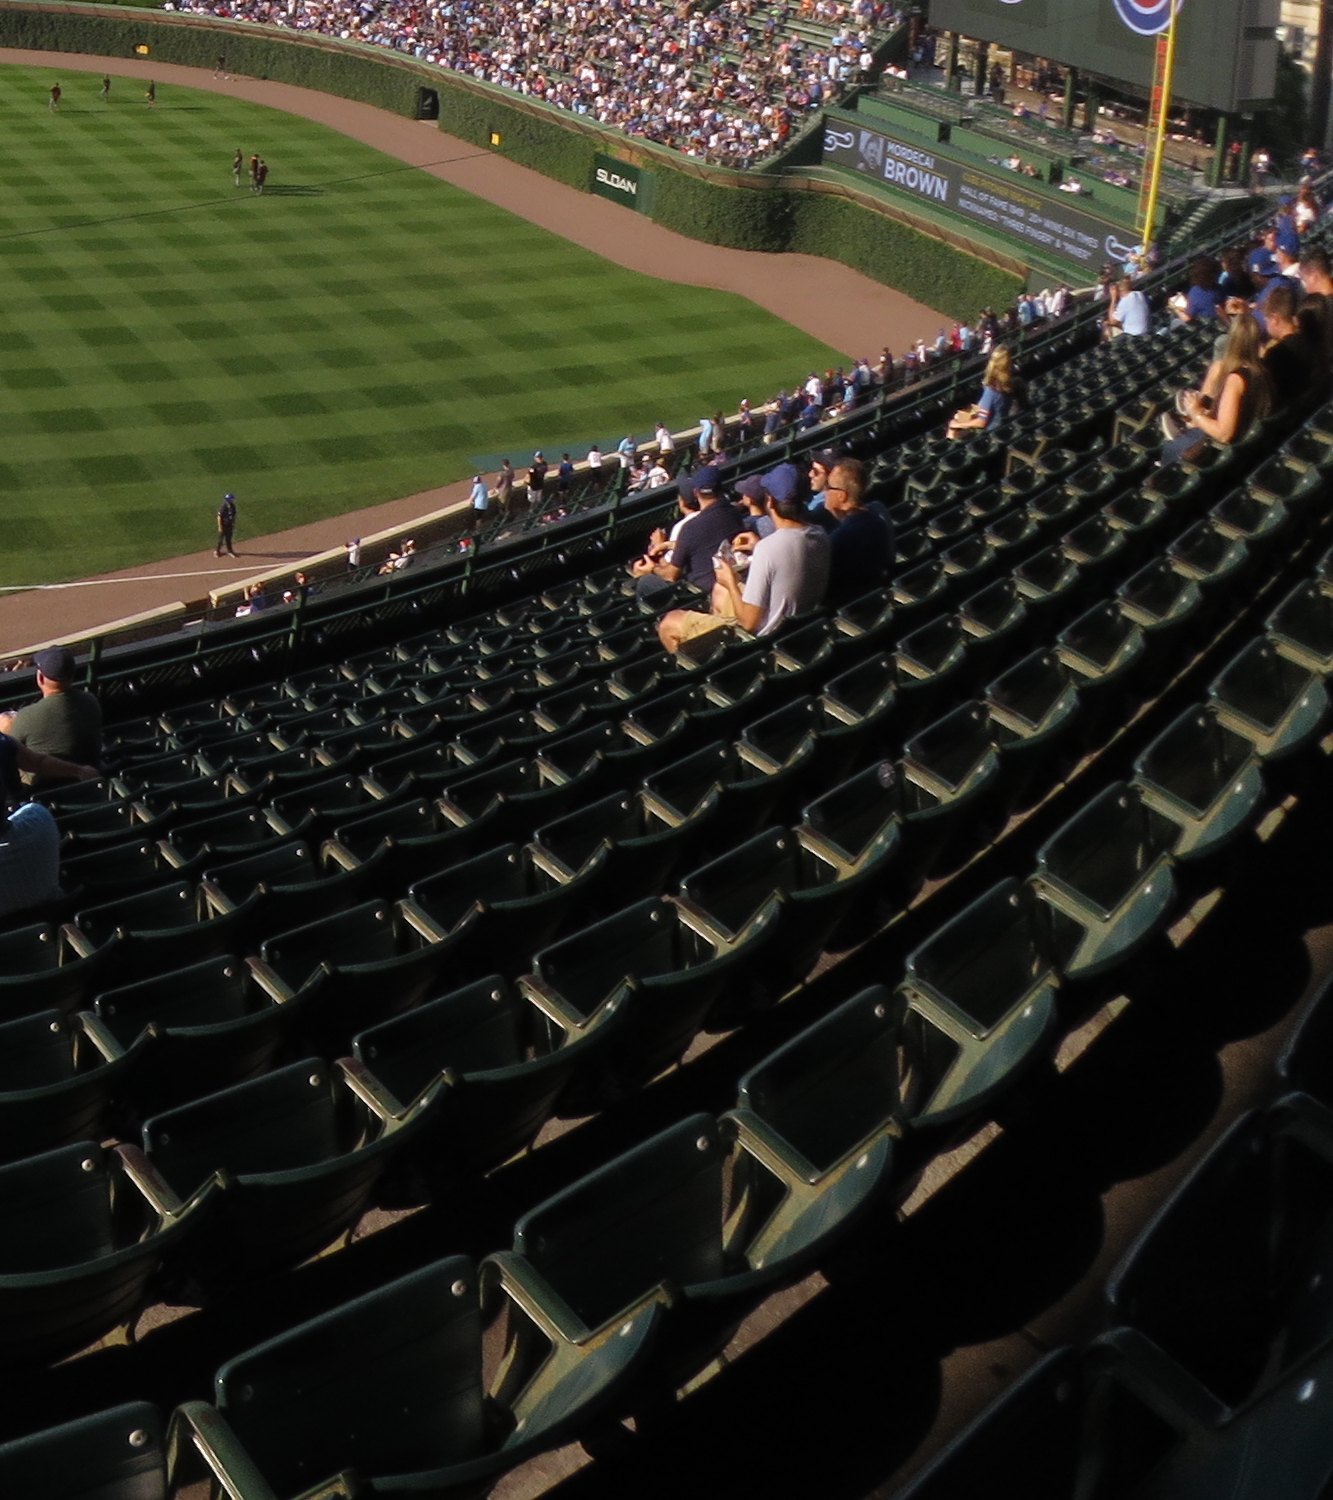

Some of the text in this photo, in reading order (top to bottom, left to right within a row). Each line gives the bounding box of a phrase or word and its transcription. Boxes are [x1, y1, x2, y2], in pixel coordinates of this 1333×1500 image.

[886, 139, 934, 170] MORDECAI
[595, 167, 638, 195] SLOAN
[884, 161, 949, 202] BROWN
